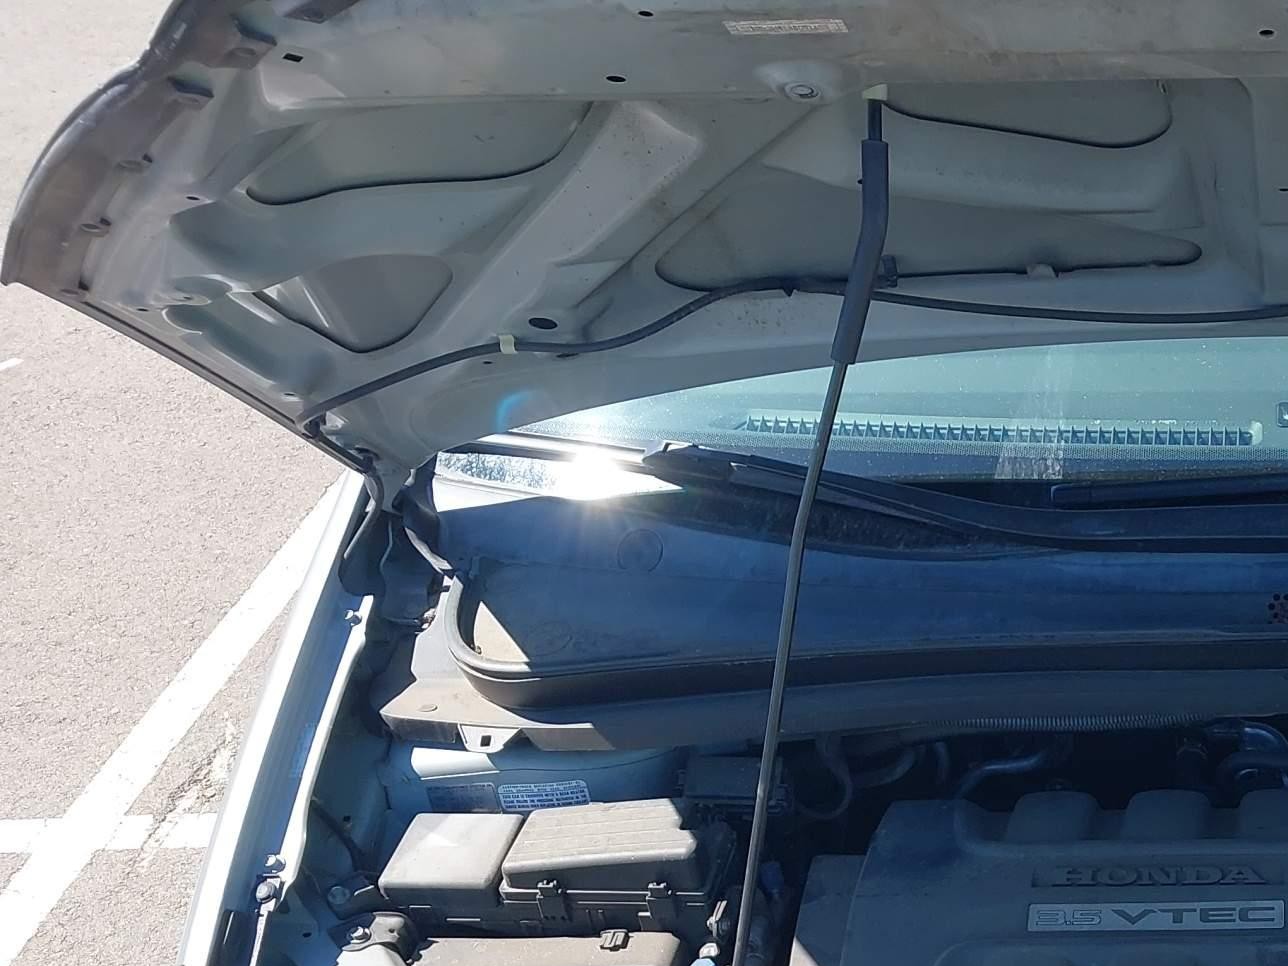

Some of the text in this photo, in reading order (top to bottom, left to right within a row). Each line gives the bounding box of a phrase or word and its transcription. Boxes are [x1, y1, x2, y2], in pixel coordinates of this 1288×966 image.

[1052, 864, 1267, 887] HONDA
[1035, 906, 1276, 926] 3.5 VTEC
